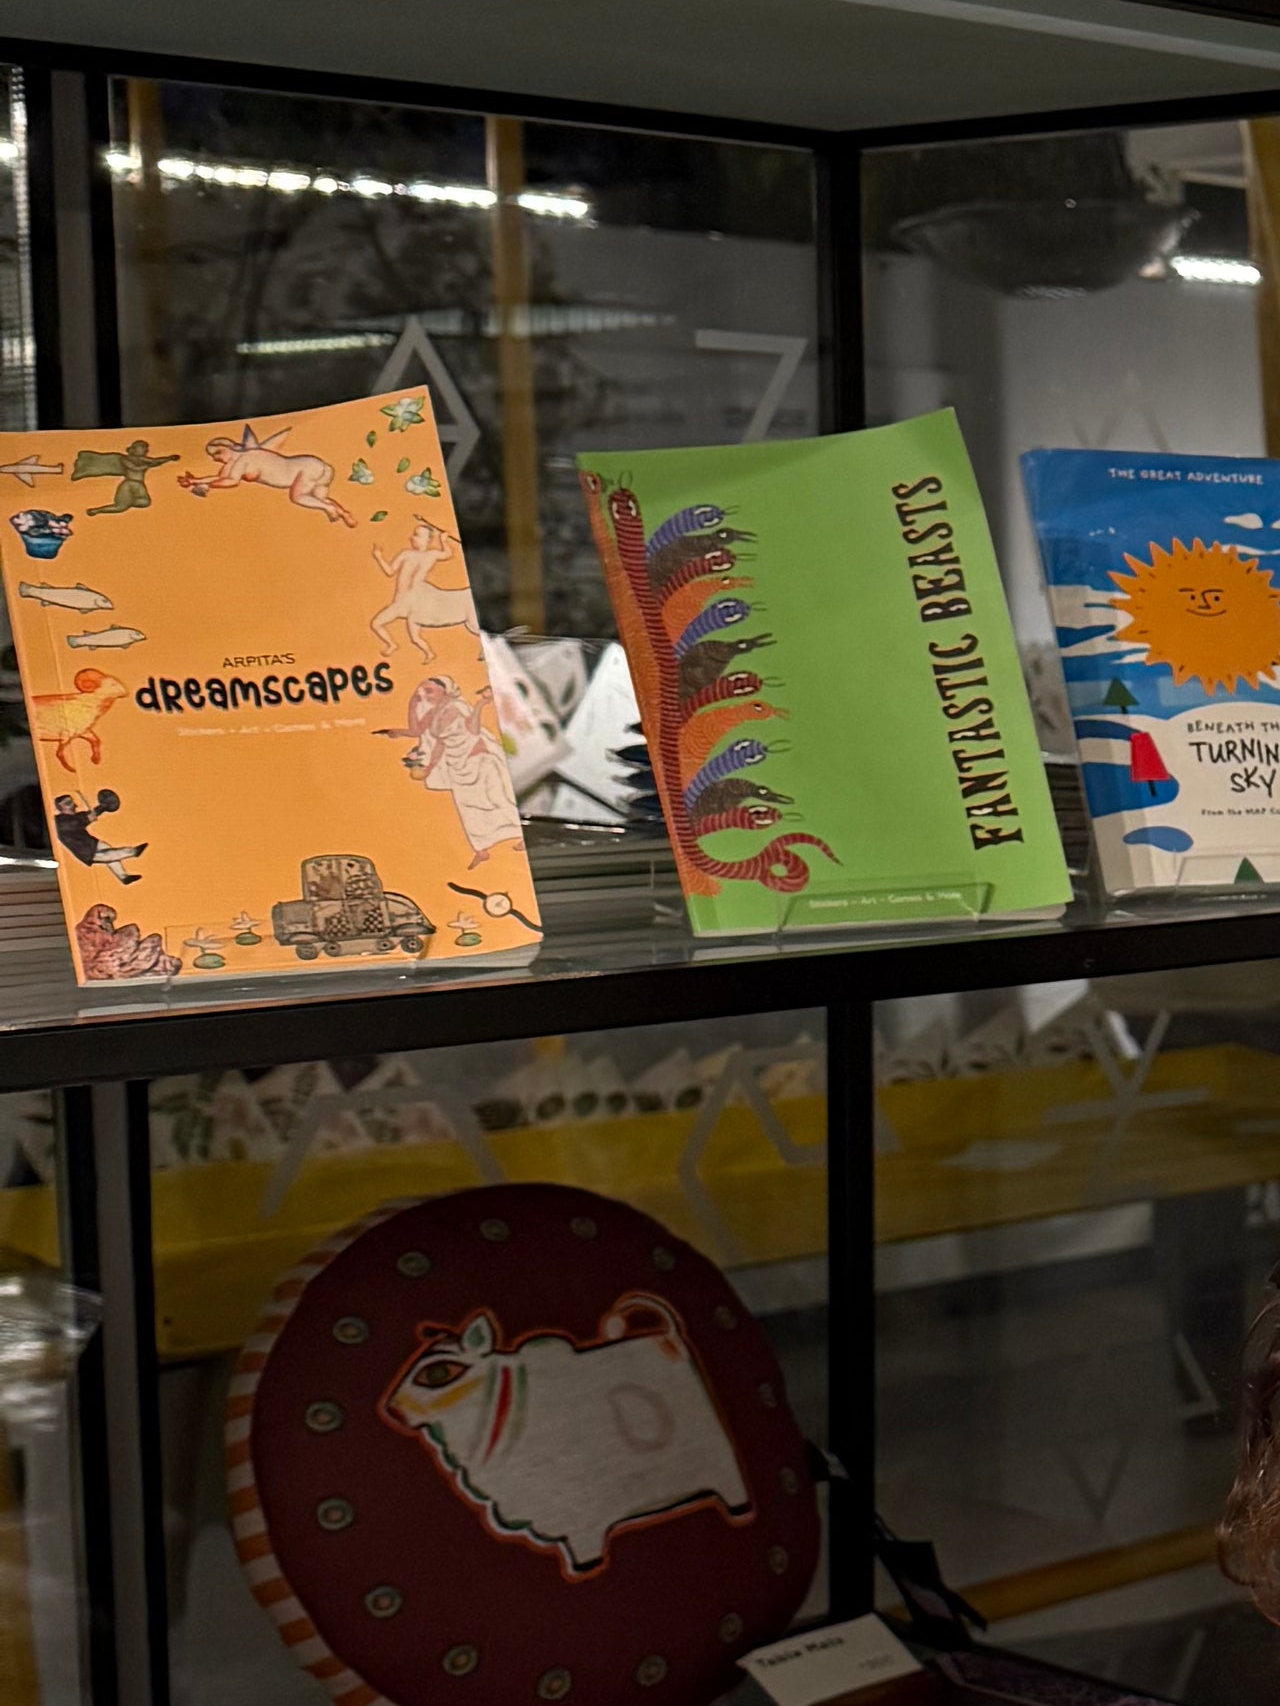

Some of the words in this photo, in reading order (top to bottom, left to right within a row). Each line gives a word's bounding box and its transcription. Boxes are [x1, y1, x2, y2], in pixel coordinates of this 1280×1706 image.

[1108, 467, 1136, 480] THE
[1140, 468, 1181, 481] GREAT
[1187, 472, 1264, 485] ADVENTURE
[891, 476, 972, 622] BEASTS
[222, 653, 297, 668] ARPITA'S
[1187, 720, 1255, 734] BENEATH
[929, 633, 1024, 850] FANTASTIC
[1230, 766, 1277, 798] SKY
